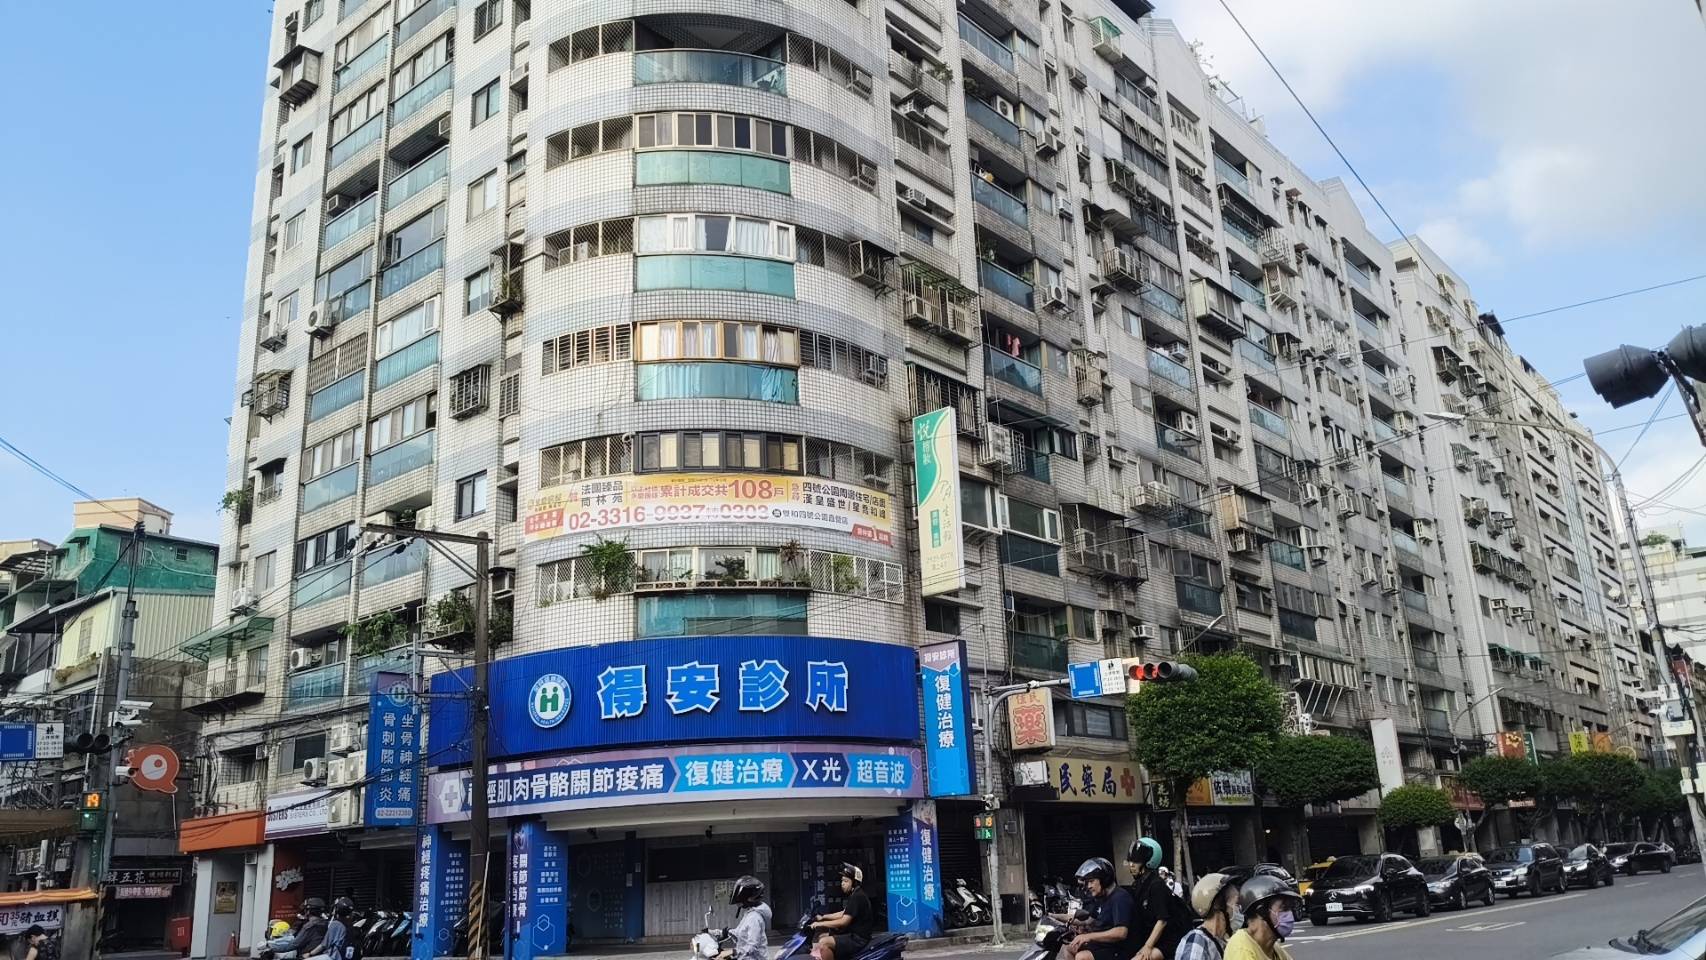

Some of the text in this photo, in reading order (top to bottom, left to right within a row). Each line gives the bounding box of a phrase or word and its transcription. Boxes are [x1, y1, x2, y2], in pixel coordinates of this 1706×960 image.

[597, 659, 849, 719] 得安診所
[935, 674, 955, 749] 復健治療
[380, 712, 396, 803] 骨刺關節炎
[398, 713, 414, 803] 坐骨神經痛
[685, 758, 784, 787] 復健治療
[802, 758, 842, 782] X光
[856, 759, 906, 786] 超音波
[1046, 762, 1117, 799] 民藥局
[518, 853, 528, 918] 關節筋骨
[920, 828, 935, 901] 復健治療
